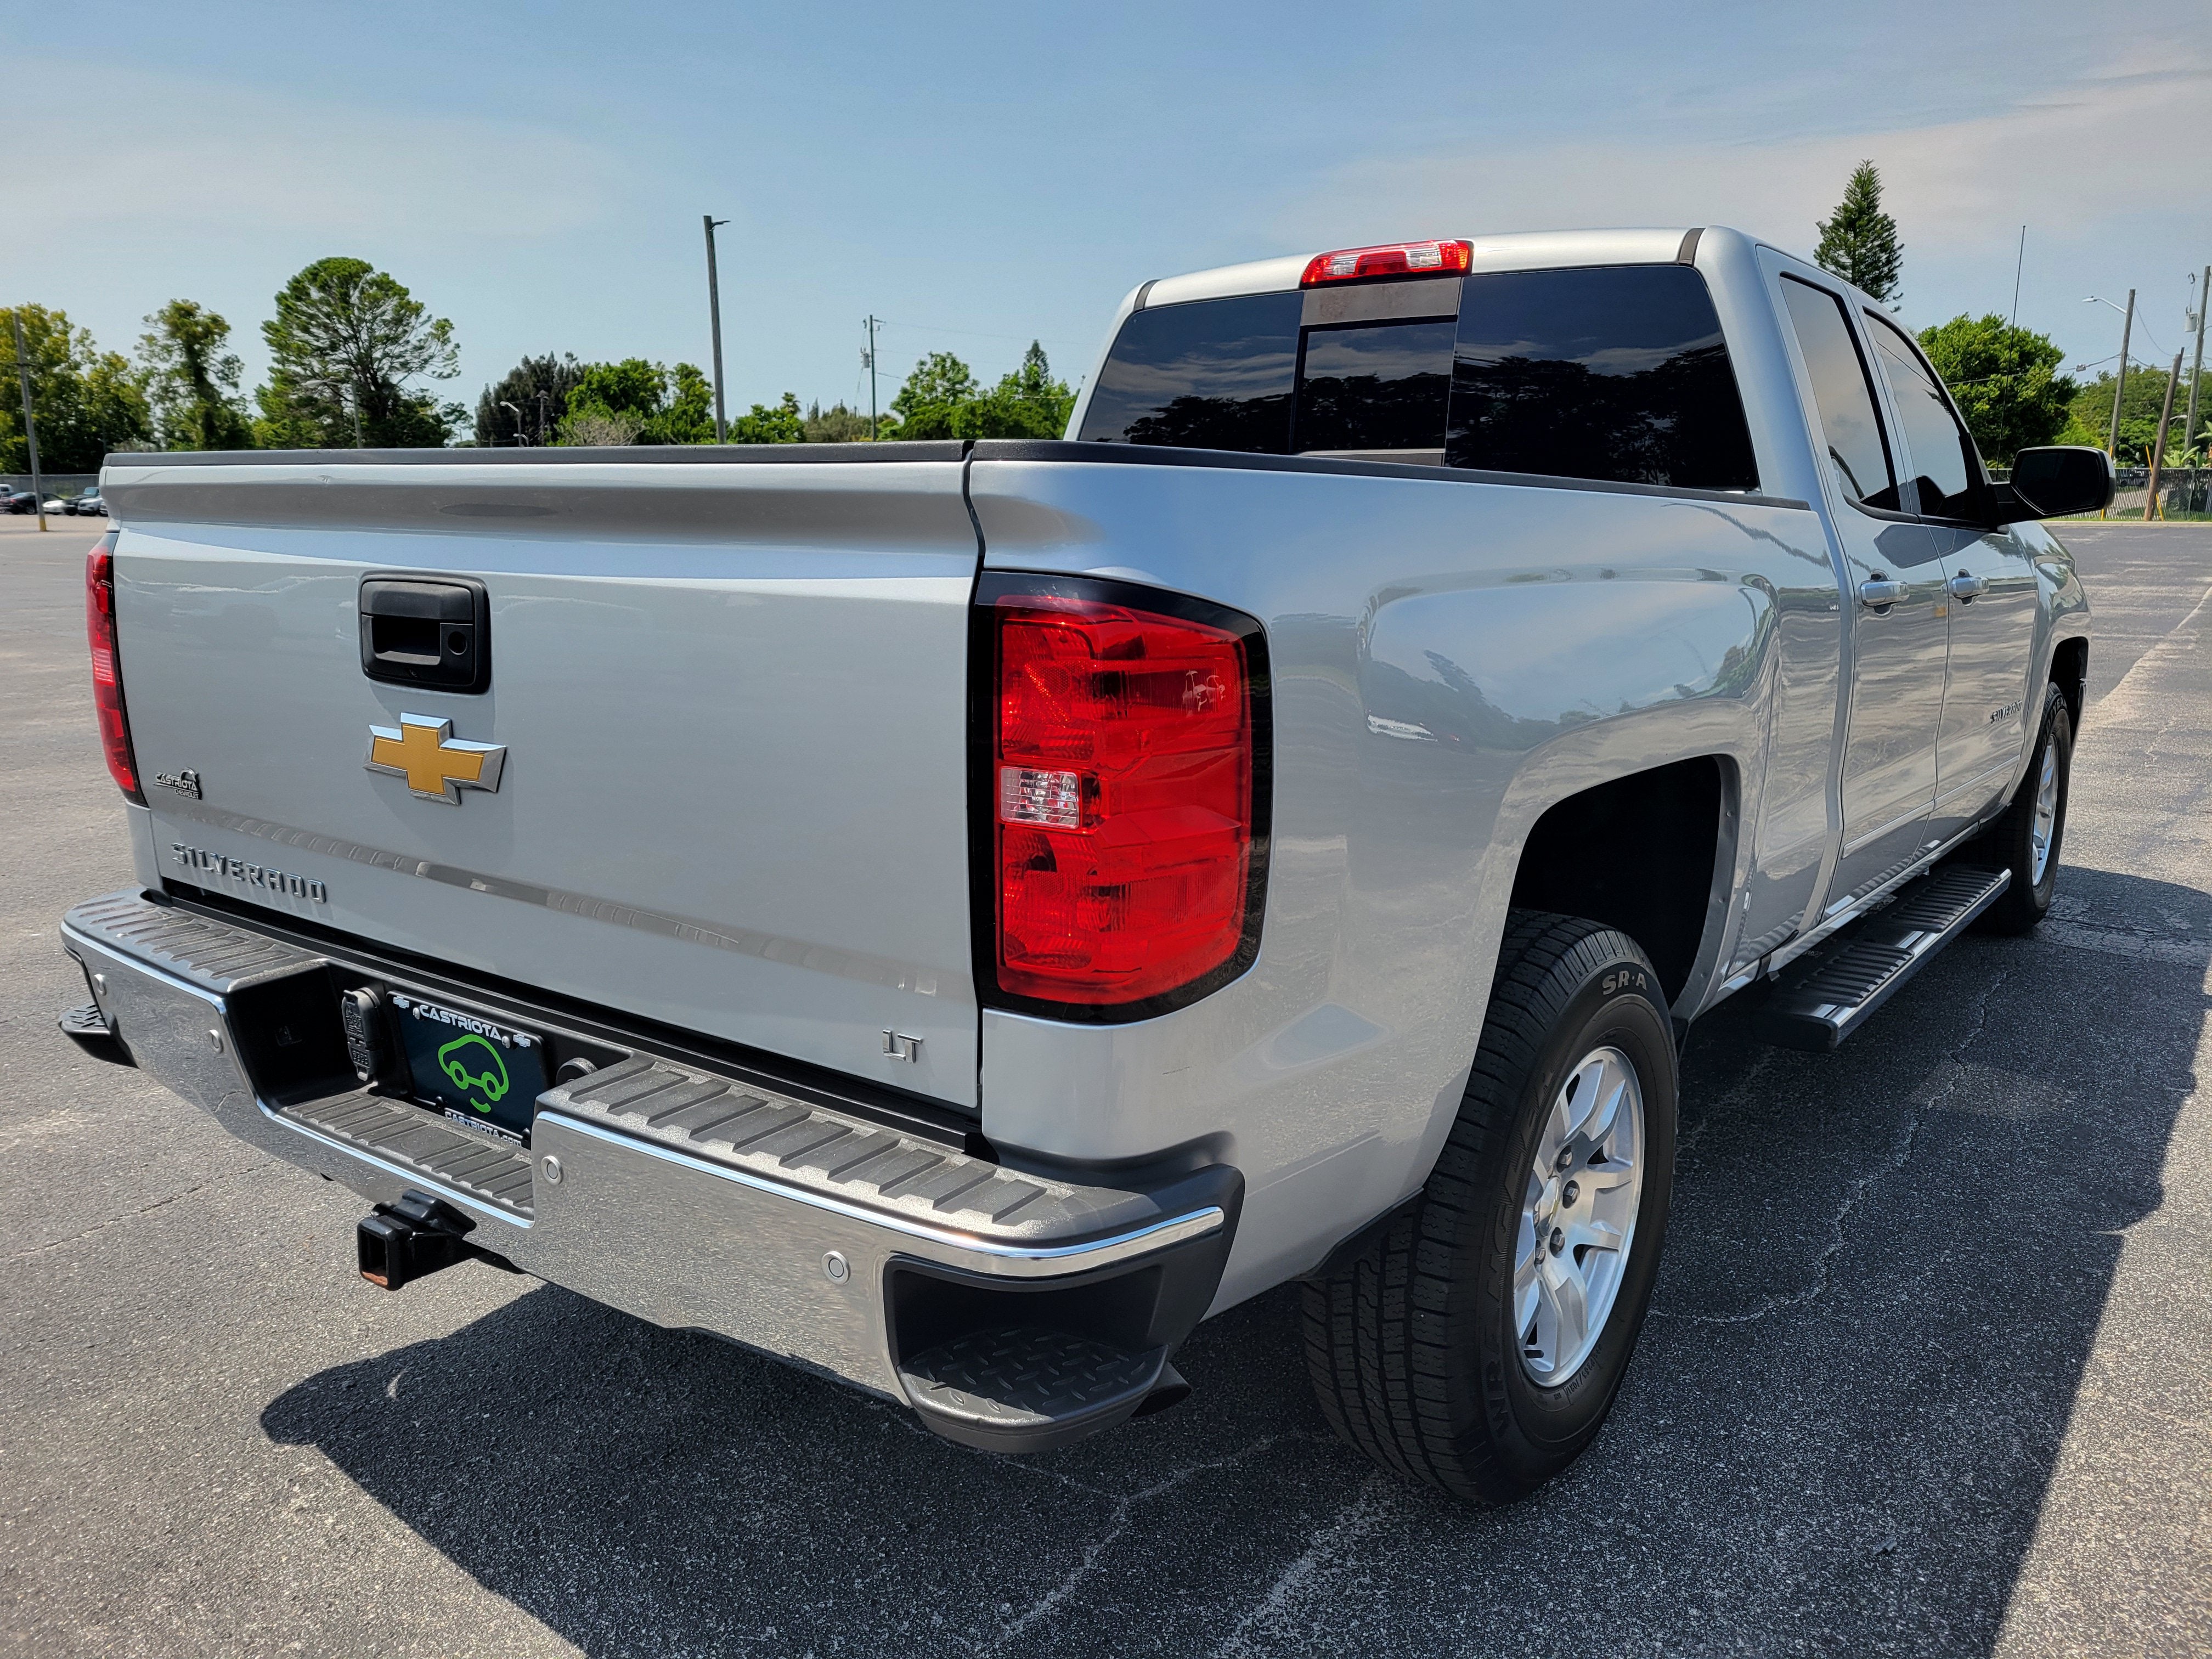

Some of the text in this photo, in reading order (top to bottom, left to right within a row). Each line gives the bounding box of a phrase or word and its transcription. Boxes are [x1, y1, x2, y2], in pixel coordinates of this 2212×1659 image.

[156, 772, 198, 791] CASTRIOTA
[174, 789, 199, 799] CHEVROLET
[171, 842, 326, 903] SILVERADO
[419, 1005, 502, 1041] CASTRIOTA
[882, 1029, 923, 1063] LT
